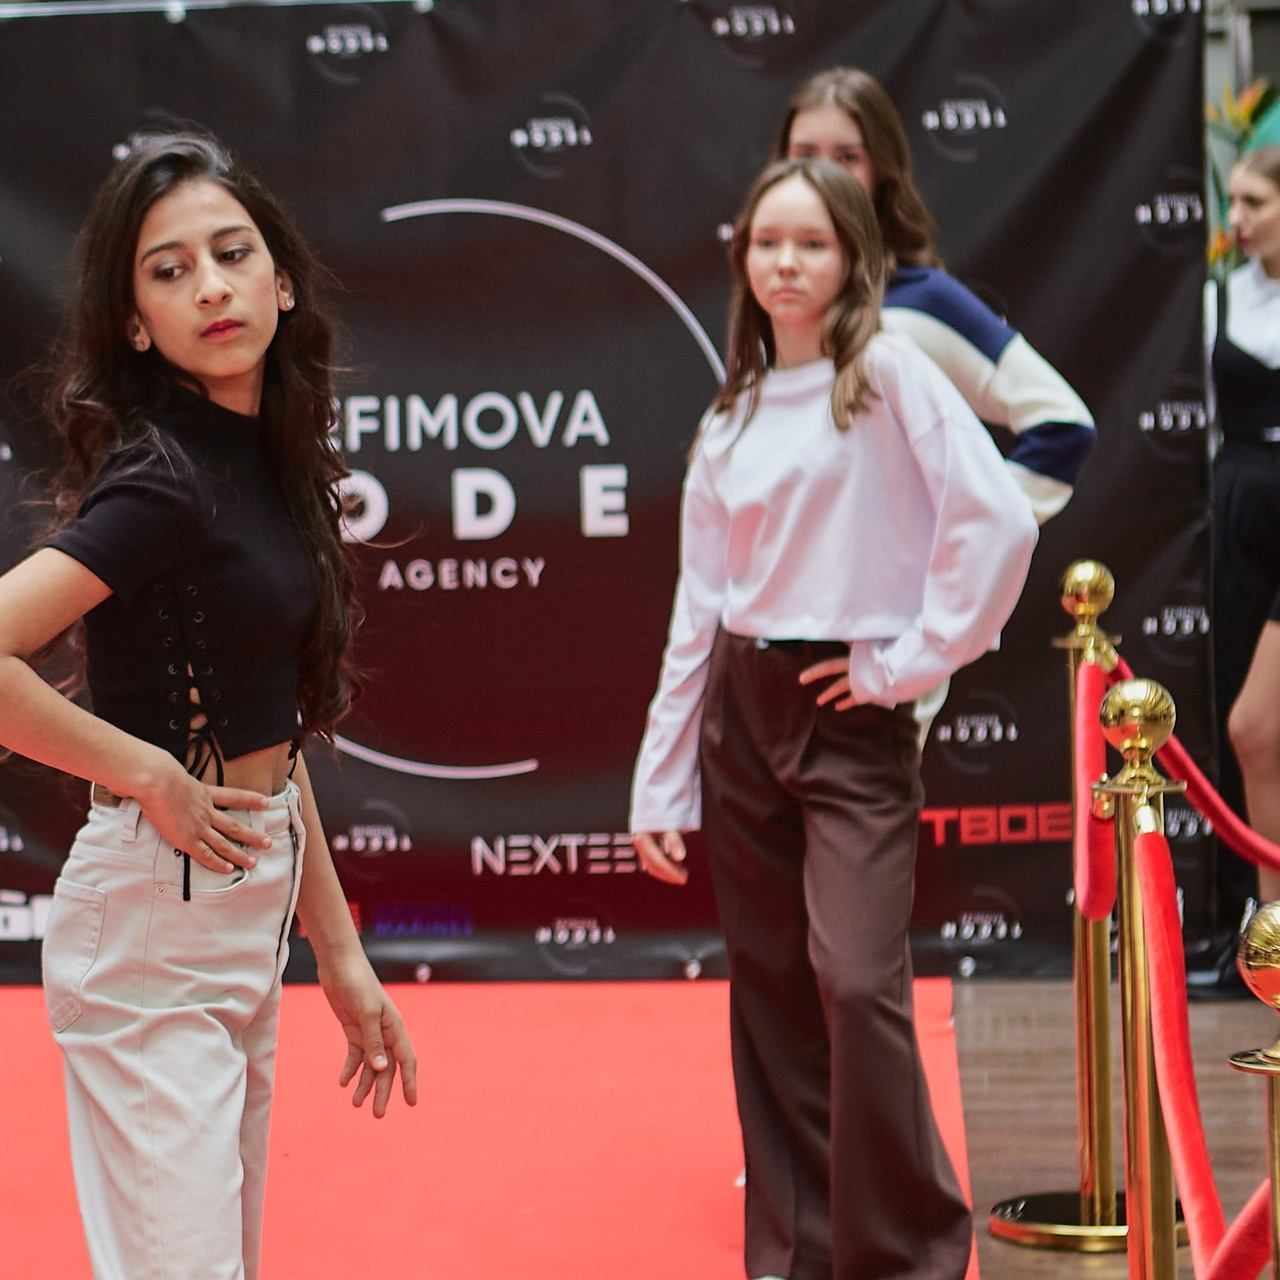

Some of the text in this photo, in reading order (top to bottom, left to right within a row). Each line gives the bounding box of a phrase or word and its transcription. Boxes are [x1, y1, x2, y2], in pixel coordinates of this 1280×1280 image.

[327, 463, 629, 544] ODE
[378, 556, 546, 591] AGENCY
[470, 832, 649, 876] NEXTEE
